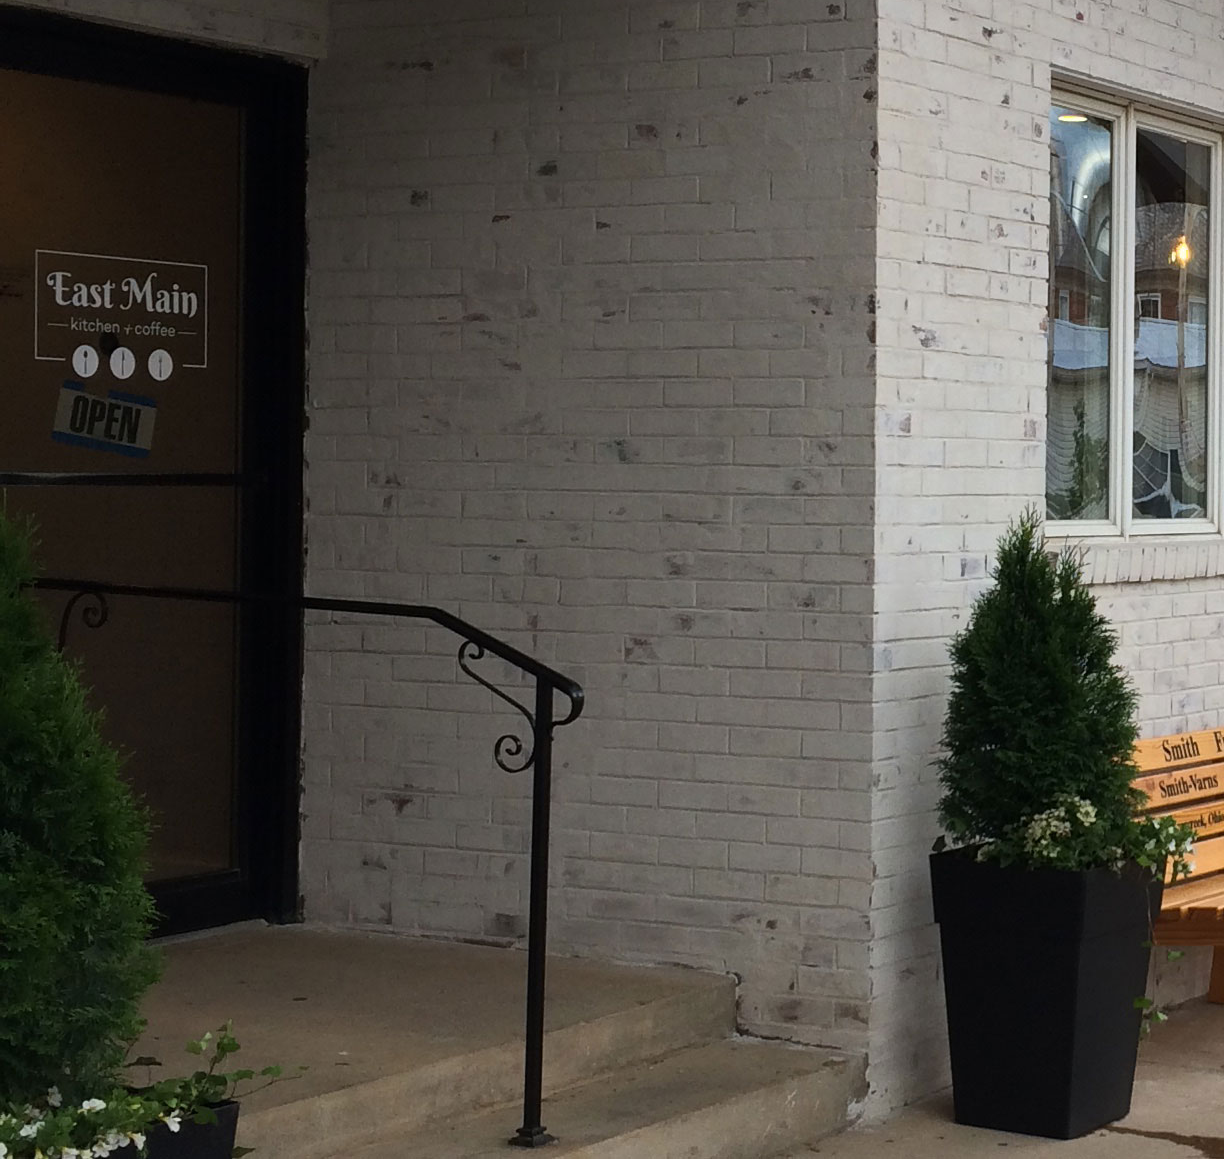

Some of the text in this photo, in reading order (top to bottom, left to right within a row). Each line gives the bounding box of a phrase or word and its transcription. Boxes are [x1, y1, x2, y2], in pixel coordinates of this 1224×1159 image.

[46, 271, 198, 318] East Main
[70, 317, 120, 334] kitchen
[134, 321, 176, 337] coffee
[69, 395, 142, 444] OPEN
[1161, 737, 1200, 762] Smith
[1159, 772, 1219, 798] Smith-Varns
[1208, 810, 1224, 825] Ohio
